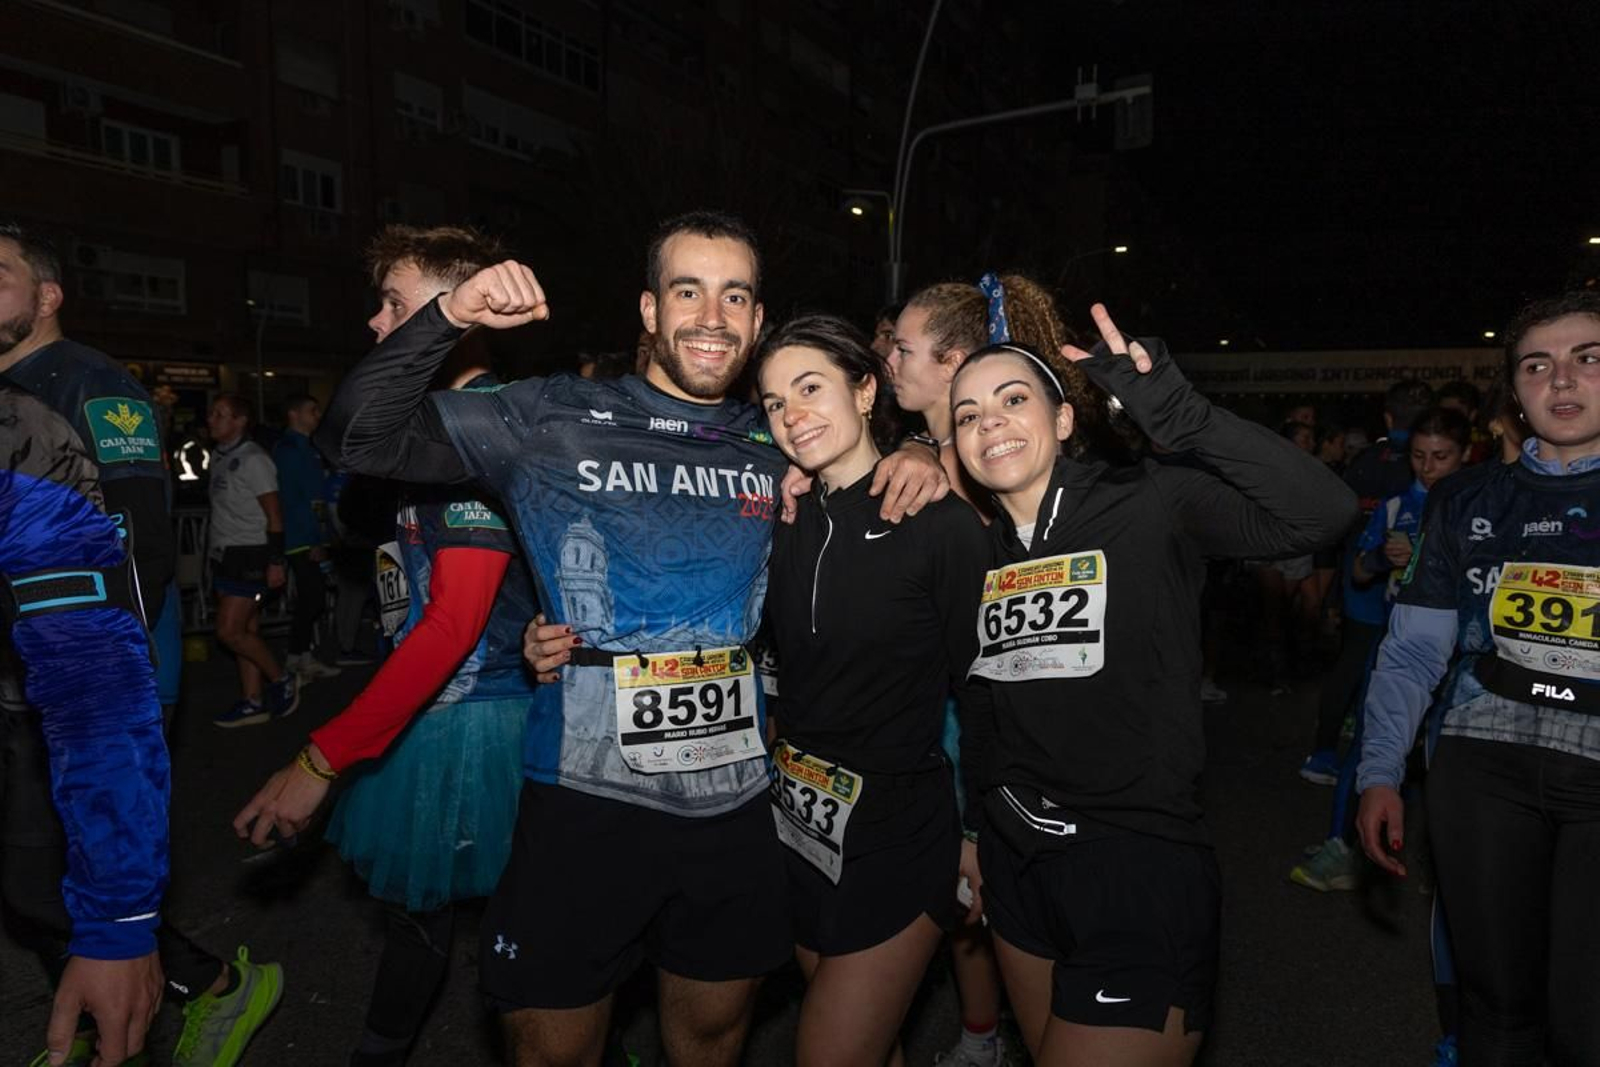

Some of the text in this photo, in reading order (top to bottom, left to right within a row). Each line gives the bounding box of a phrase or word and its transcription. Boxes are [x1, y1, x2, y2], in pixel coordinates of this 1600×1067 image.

[1321, 365, 1467, 381] INTERNACIONAL
[577, 459, 774, 504] SAN ANTÓN
[737, 492, 774, 521] 202
[998, 569, 1018, 593] 42
[1466, 566, 1501, 596] SA
[1530, 568, 1561, 590] 42
[985, 588, 1088, 641] 6532
[632, 679, 741, 729] 8591
[1531, 682, 1576, 702] FILA
